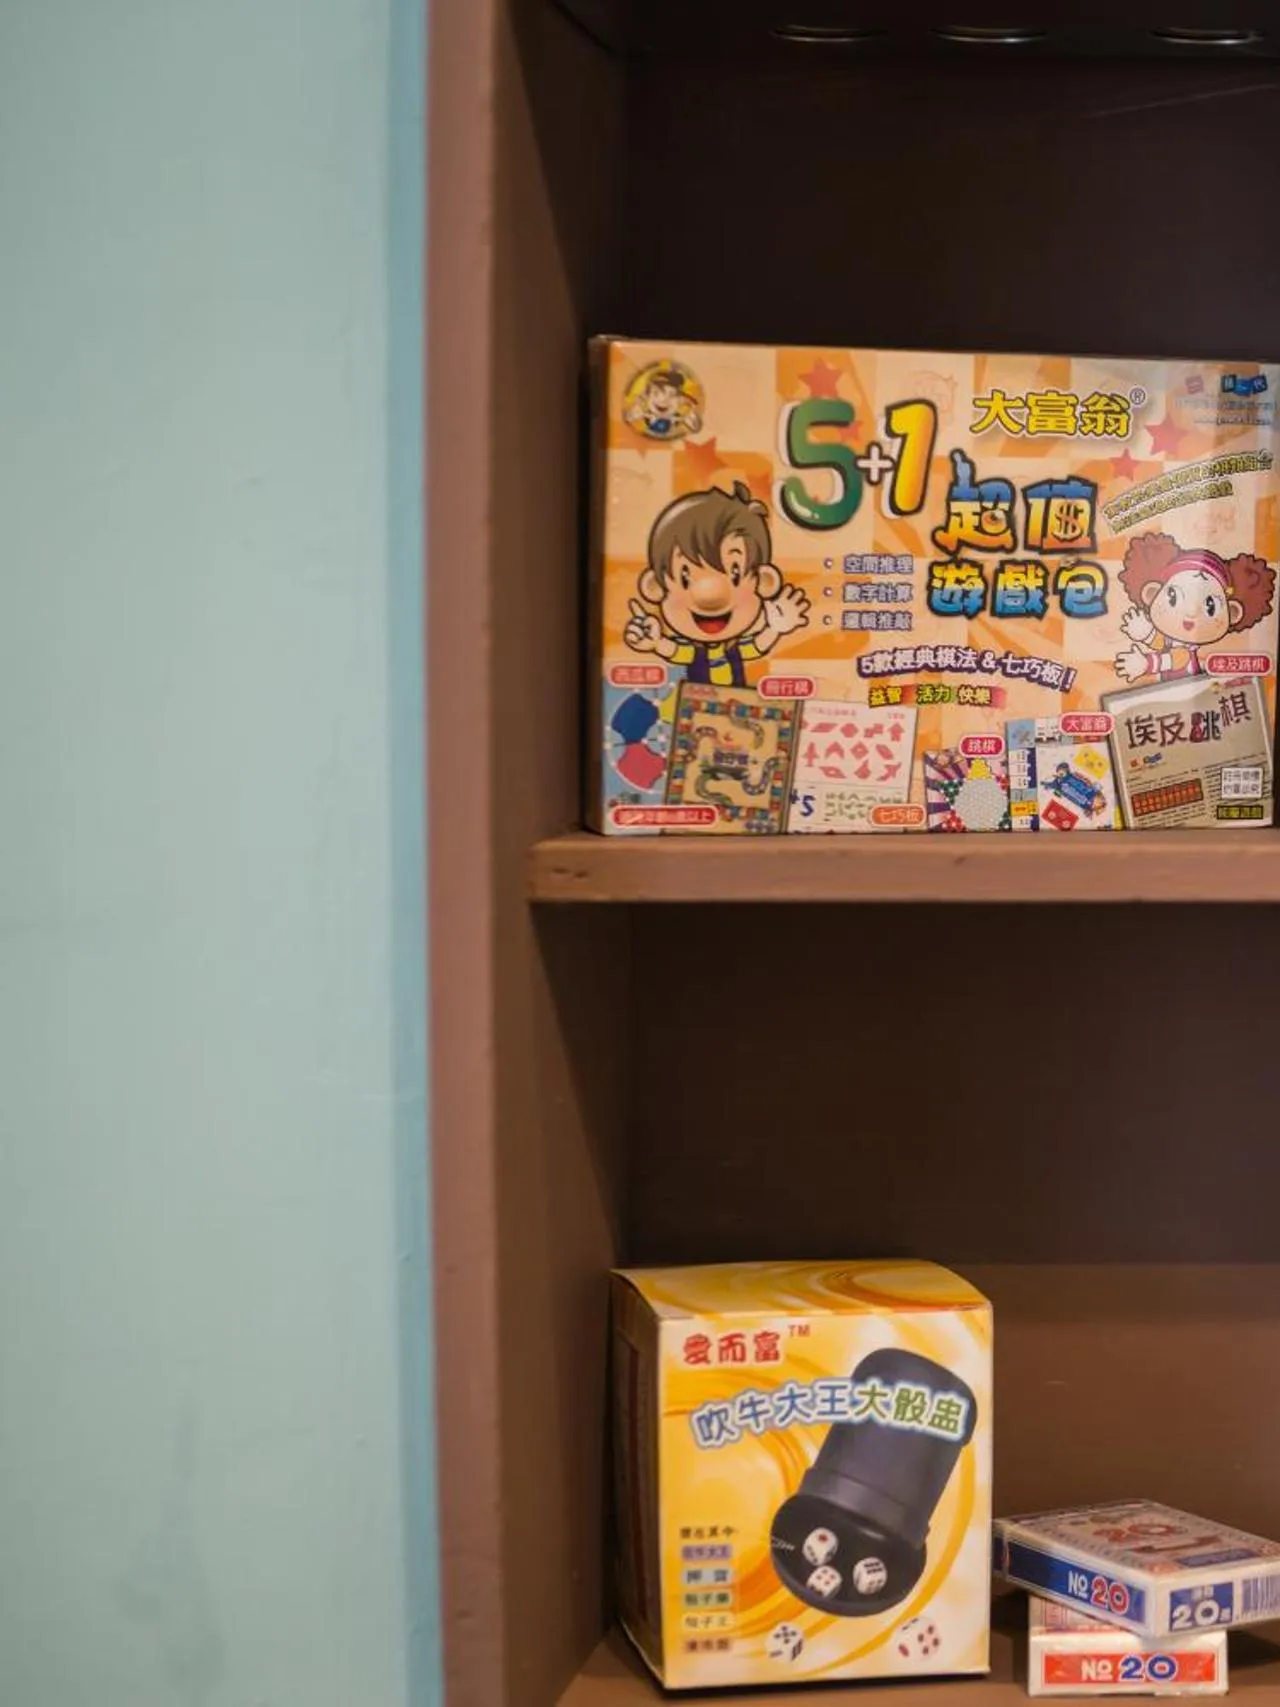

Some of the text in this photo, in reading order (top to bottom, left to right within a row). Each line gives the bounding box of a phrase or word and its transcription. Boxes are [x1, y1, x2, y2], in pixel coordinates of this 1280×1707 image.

[969, 388, 1132, 438] 大富翁
[777, 398, 938, 532] 5+1
[843, 555, 914, 574] 空間推理
[843, 583, 913, 603] 數字計算
[928, 558, 1109, 622] 遊戲包
[1212, 658, 1265, 672] 埃及跳棋
[916, 684, 950, 704] 活力
[957, 685, 992, 706] 快樂
[1125, 691, 1252, 749] 埃及跳棋
[788, 1324, 811, 1337] TM
[693, 1380, 967, 1444] 吹牛大王大骰盅
[1090, 1575, 1130, 1615] 20
[1171, 1598, 1220, 1630] 20
[1118, 1653, 1178, 1683] 20
